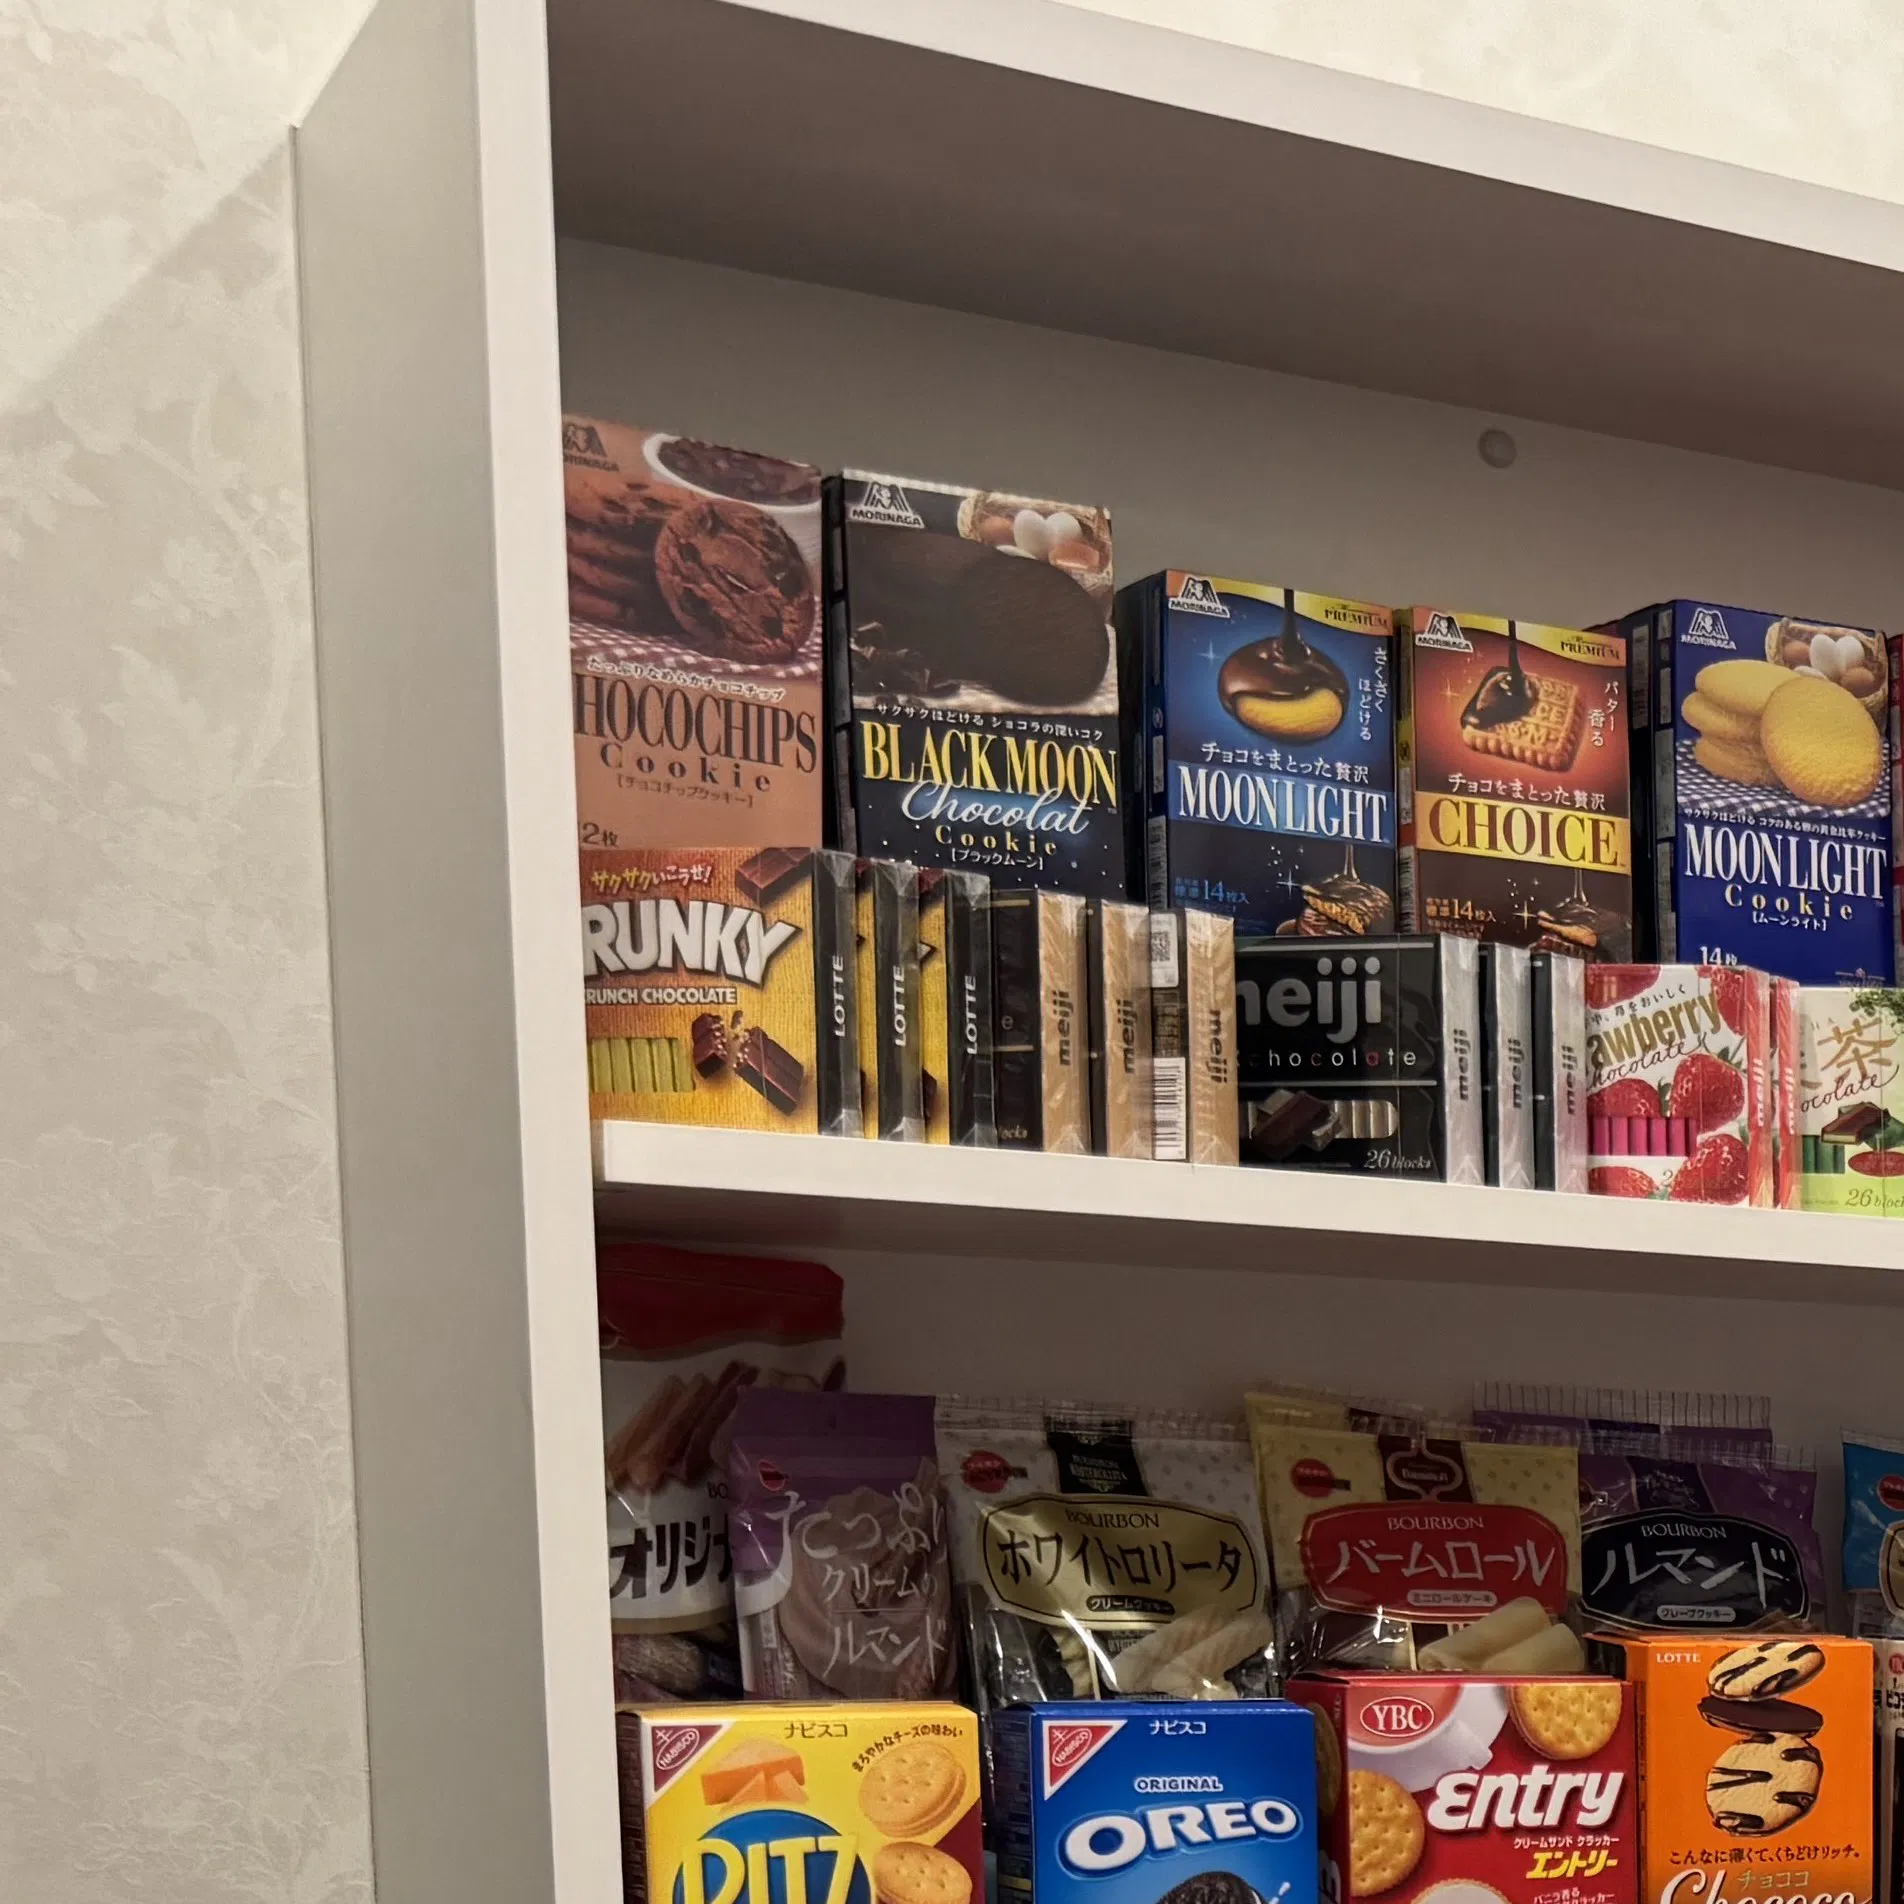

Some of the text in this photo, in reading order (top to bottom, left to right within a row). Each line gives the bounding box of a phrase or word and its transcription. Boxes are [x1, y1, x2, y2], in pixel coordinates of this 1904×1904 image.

[852, 507, 925, 529] MORINAGA
[1170, 600, 1230, 619] MORINAGA
[1416, 635, 1473, 653] MORINAGA
[1681, 632, 1737, 650] MORINAGA
[598, 747, 773, 792] Cookie
[860, 721, 1119, 808] BLACK MOON
[1201, 741, 1370, 784] チョコをまとった贅沢
[1448, 771, 1606, 811] チョコをまとった贅沢
[902, 782, 1091, 837] Chocolat
[935, 824, 1059, 857] Cookie
[1429, 799, 1621, 868] CHOICE
[1724, 884, 1854, 920] Cookie
[584, 986, 738, 1006] RUNCH CHOCOLATE
[832, 953, 847, 1040] LOTTE
[893, 965, 908, 1048] LOTTE
[964, 974, 979, 1056] LOTTE
[1065, 1508, 1160, 1530] BOURBON
[1387, 1515, 1484, 1532] BOURBON
[1640, 1523, 1726, 1540] BOURBON
[998, 1534, 1243, 1592] ホワイトロリータ
[1329, 1539, 1560, 1586] バームロール
[1589, 1541, 1792, 1608] ルマンド
[1656, 1652, 1701, 1663] LOTTE
[1372, 1703, 1422, 1730] YBC
[657, 1720, 849, 1767] NABISCO ナビスコ
[1053, 1719, 1207, 1765] NABISCO ナビスコ
[1135, 1777, 1223, 1793] ORIGINAL
[1064, 1801, 1297, 1867] OREO
[1514, 1835, 1620, 1849] クリームサンド クラッカー
[1526, 1855, 1618, 1880] エントリー
[1737, 1871, 1810, 1890] チョココ
